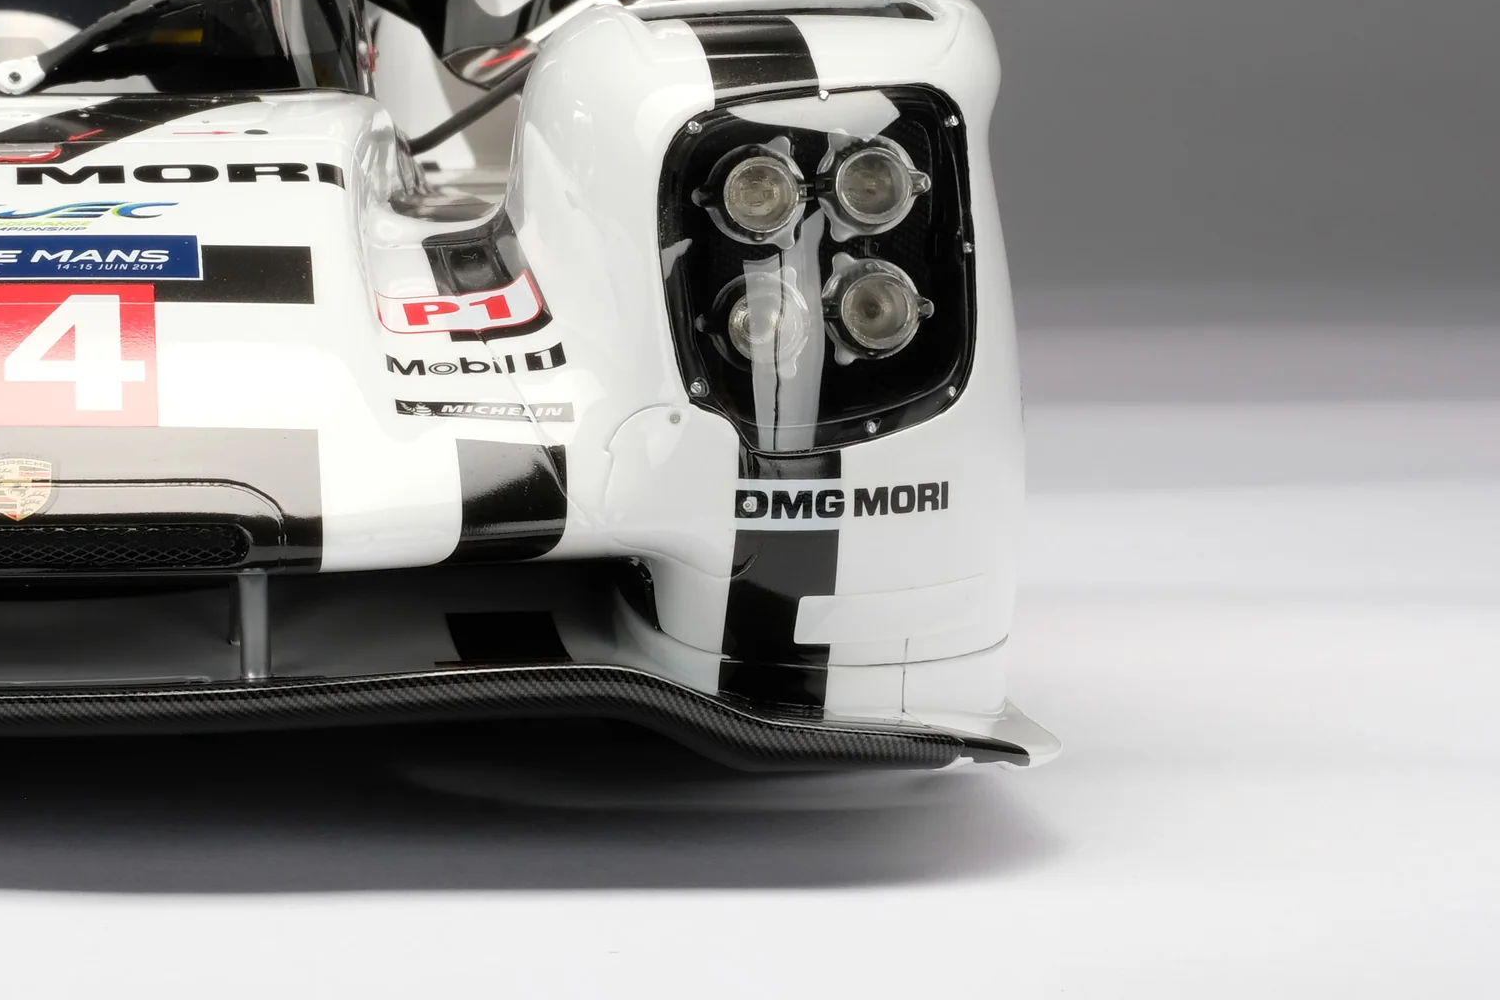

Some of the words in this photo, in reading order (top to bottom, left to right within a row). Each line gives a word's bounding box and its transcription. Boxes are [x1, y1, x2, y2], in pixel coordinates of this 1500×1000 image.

[17, 162, 346, 190] MORI
[30, 249, 170, 263] MANS
[98, 263, 129, 271] JUIN
[132, 263, 164, 271] 2014
[402, 294, 512, 327] P1
[385, 353, 516, 376] Mobil
[734, 489, 845, 519] DMG
[853, 480, 949, 517] MORI
